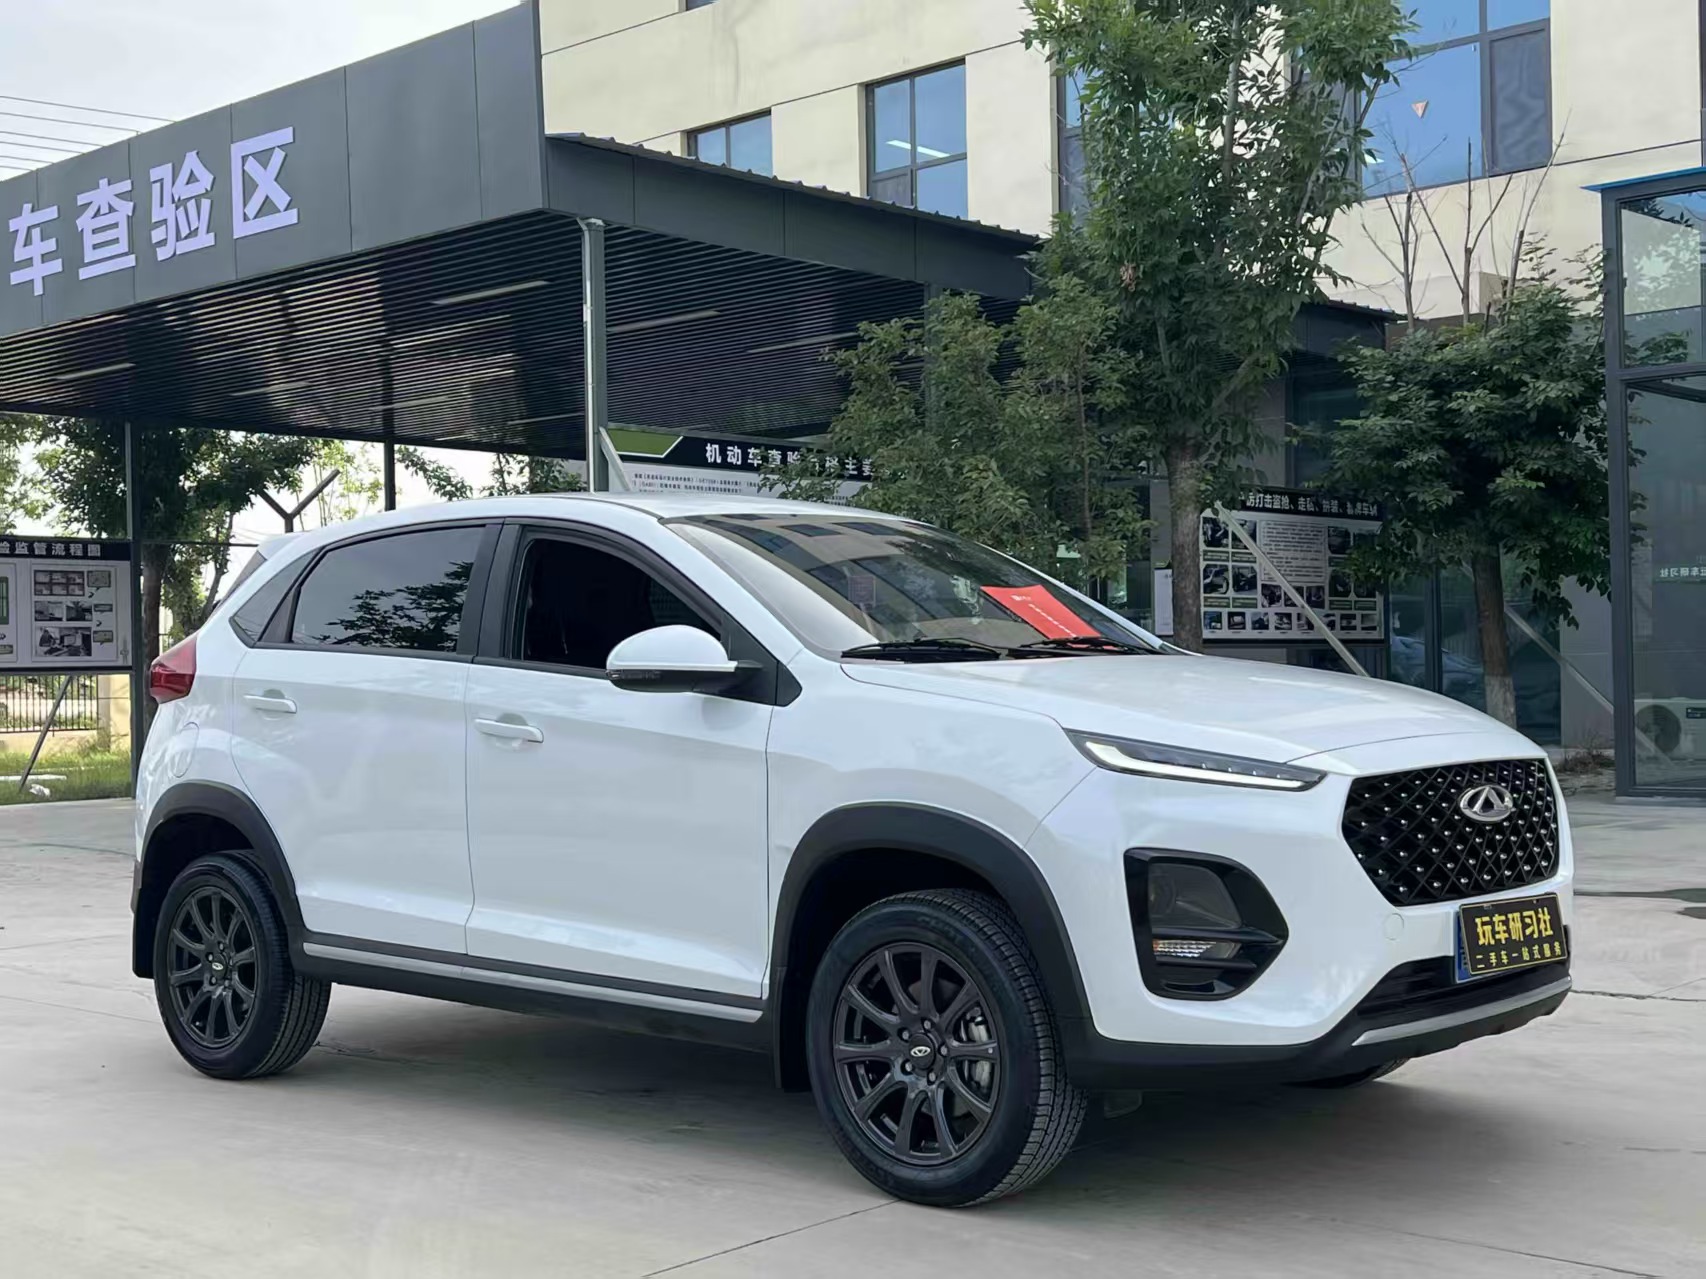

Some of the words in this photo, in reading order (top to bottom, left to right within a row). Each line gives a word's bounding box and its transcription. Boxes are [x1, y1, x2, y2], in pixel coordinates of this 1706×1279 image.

[9, 126, 299, 296] 车查验区
[1475, 906, 1553, 945] 玩车研习社
[1475, 941, 1561, 968] 二手车一站式服务
